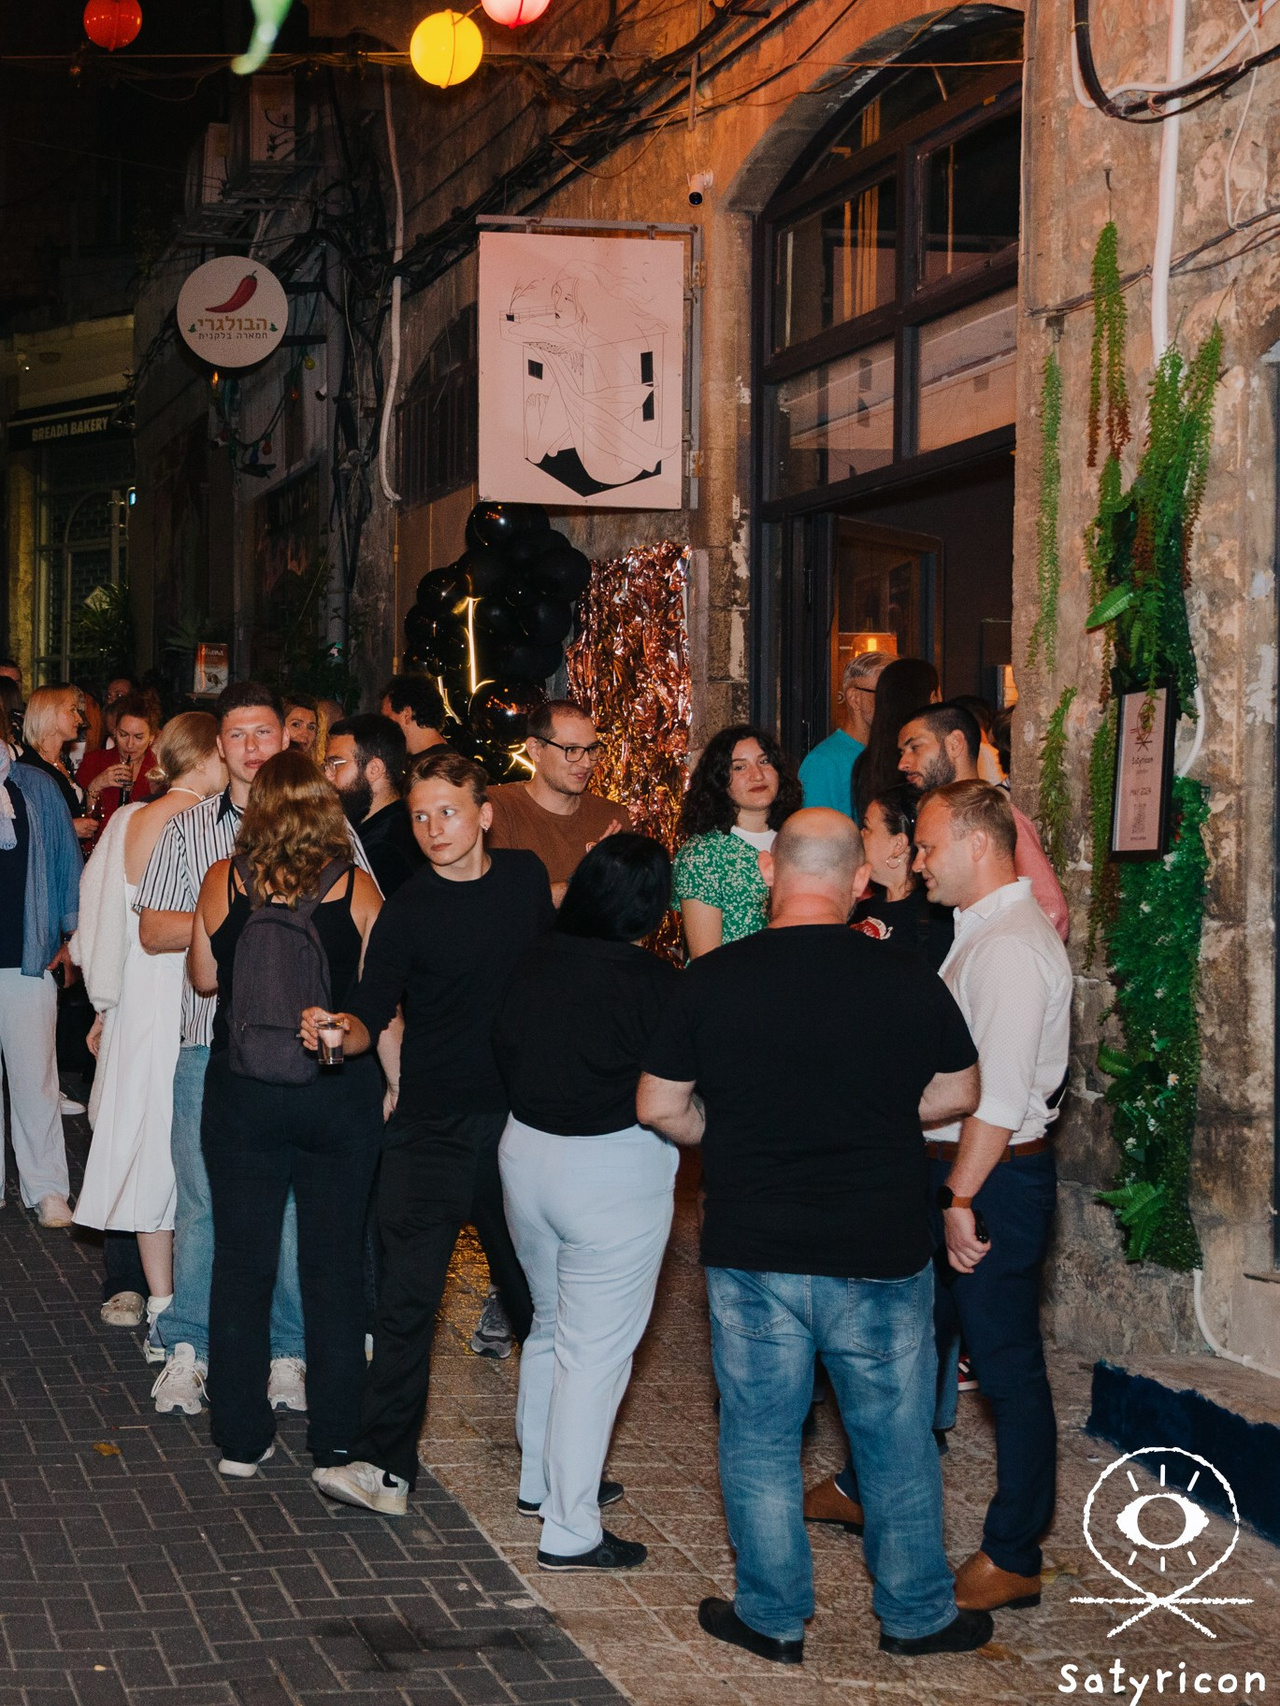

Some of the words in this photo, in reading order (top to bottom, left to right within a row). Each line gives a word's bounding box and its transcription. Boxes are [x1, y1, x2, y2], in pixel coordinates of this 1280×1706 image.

[197, 315, 268, 331] הבולגרי
[198, 331, 232, 341] בלקנית
[70, 416, 109, 435] BAKERY
